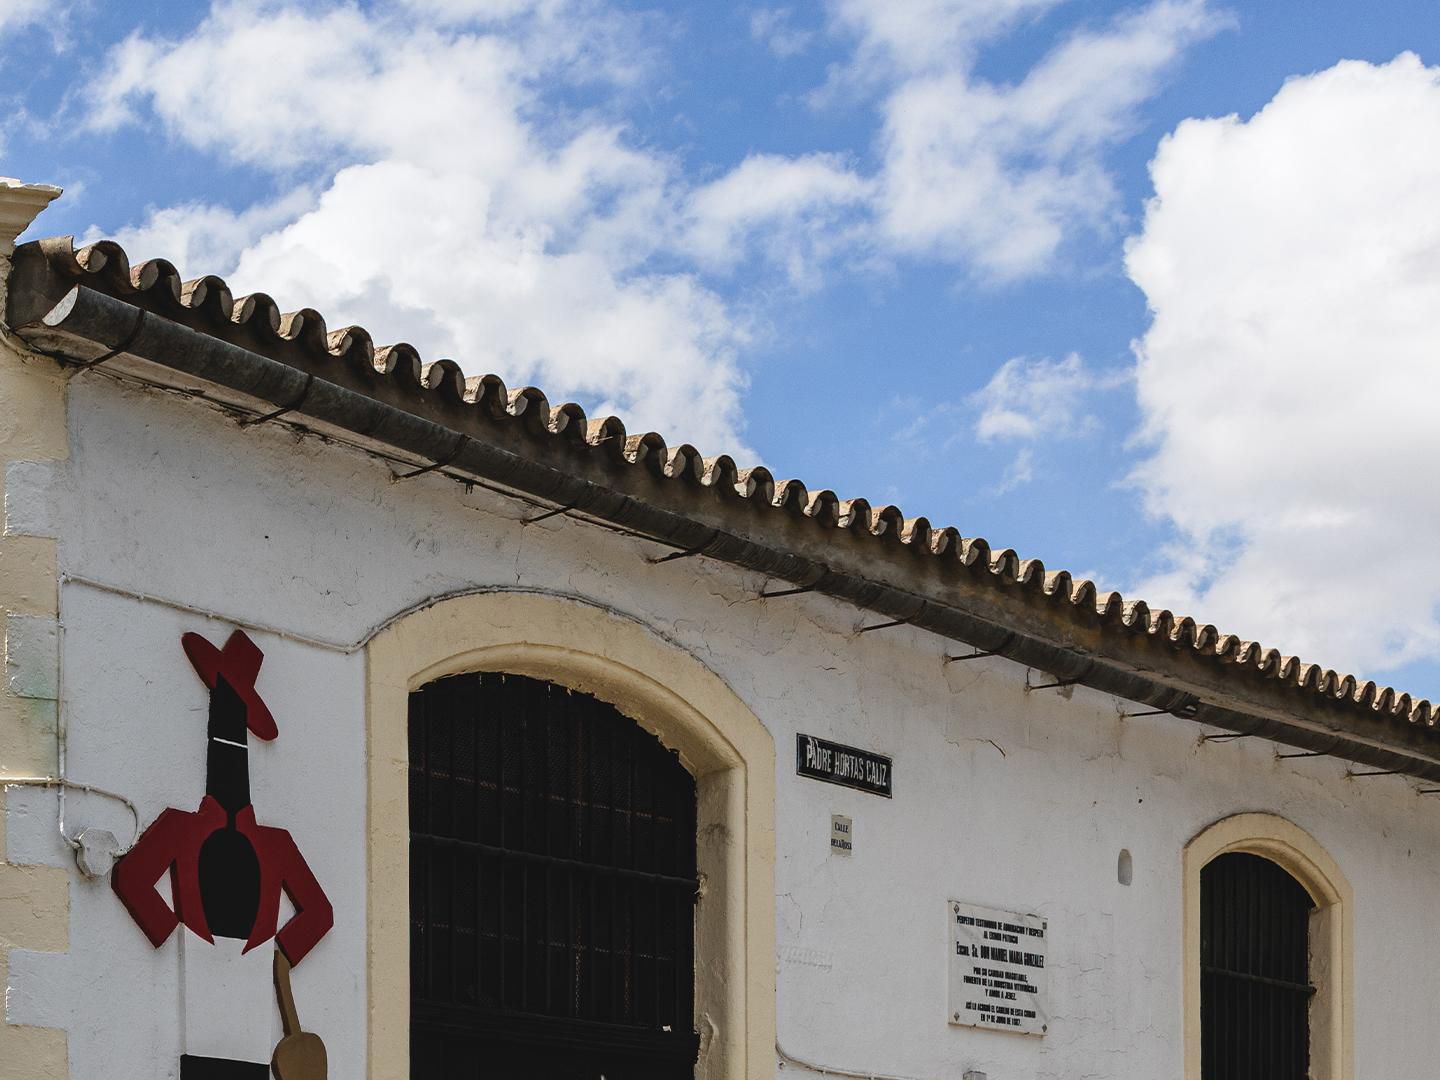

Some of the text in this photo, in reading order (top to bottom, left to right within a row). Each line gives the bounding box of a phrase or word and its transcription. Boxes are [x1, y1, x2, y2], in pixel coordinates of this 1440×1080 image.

[806, 743, 887, 787] PADRE HORTAS CALIZ
[990, 946, 1008, 962] MANUEL
